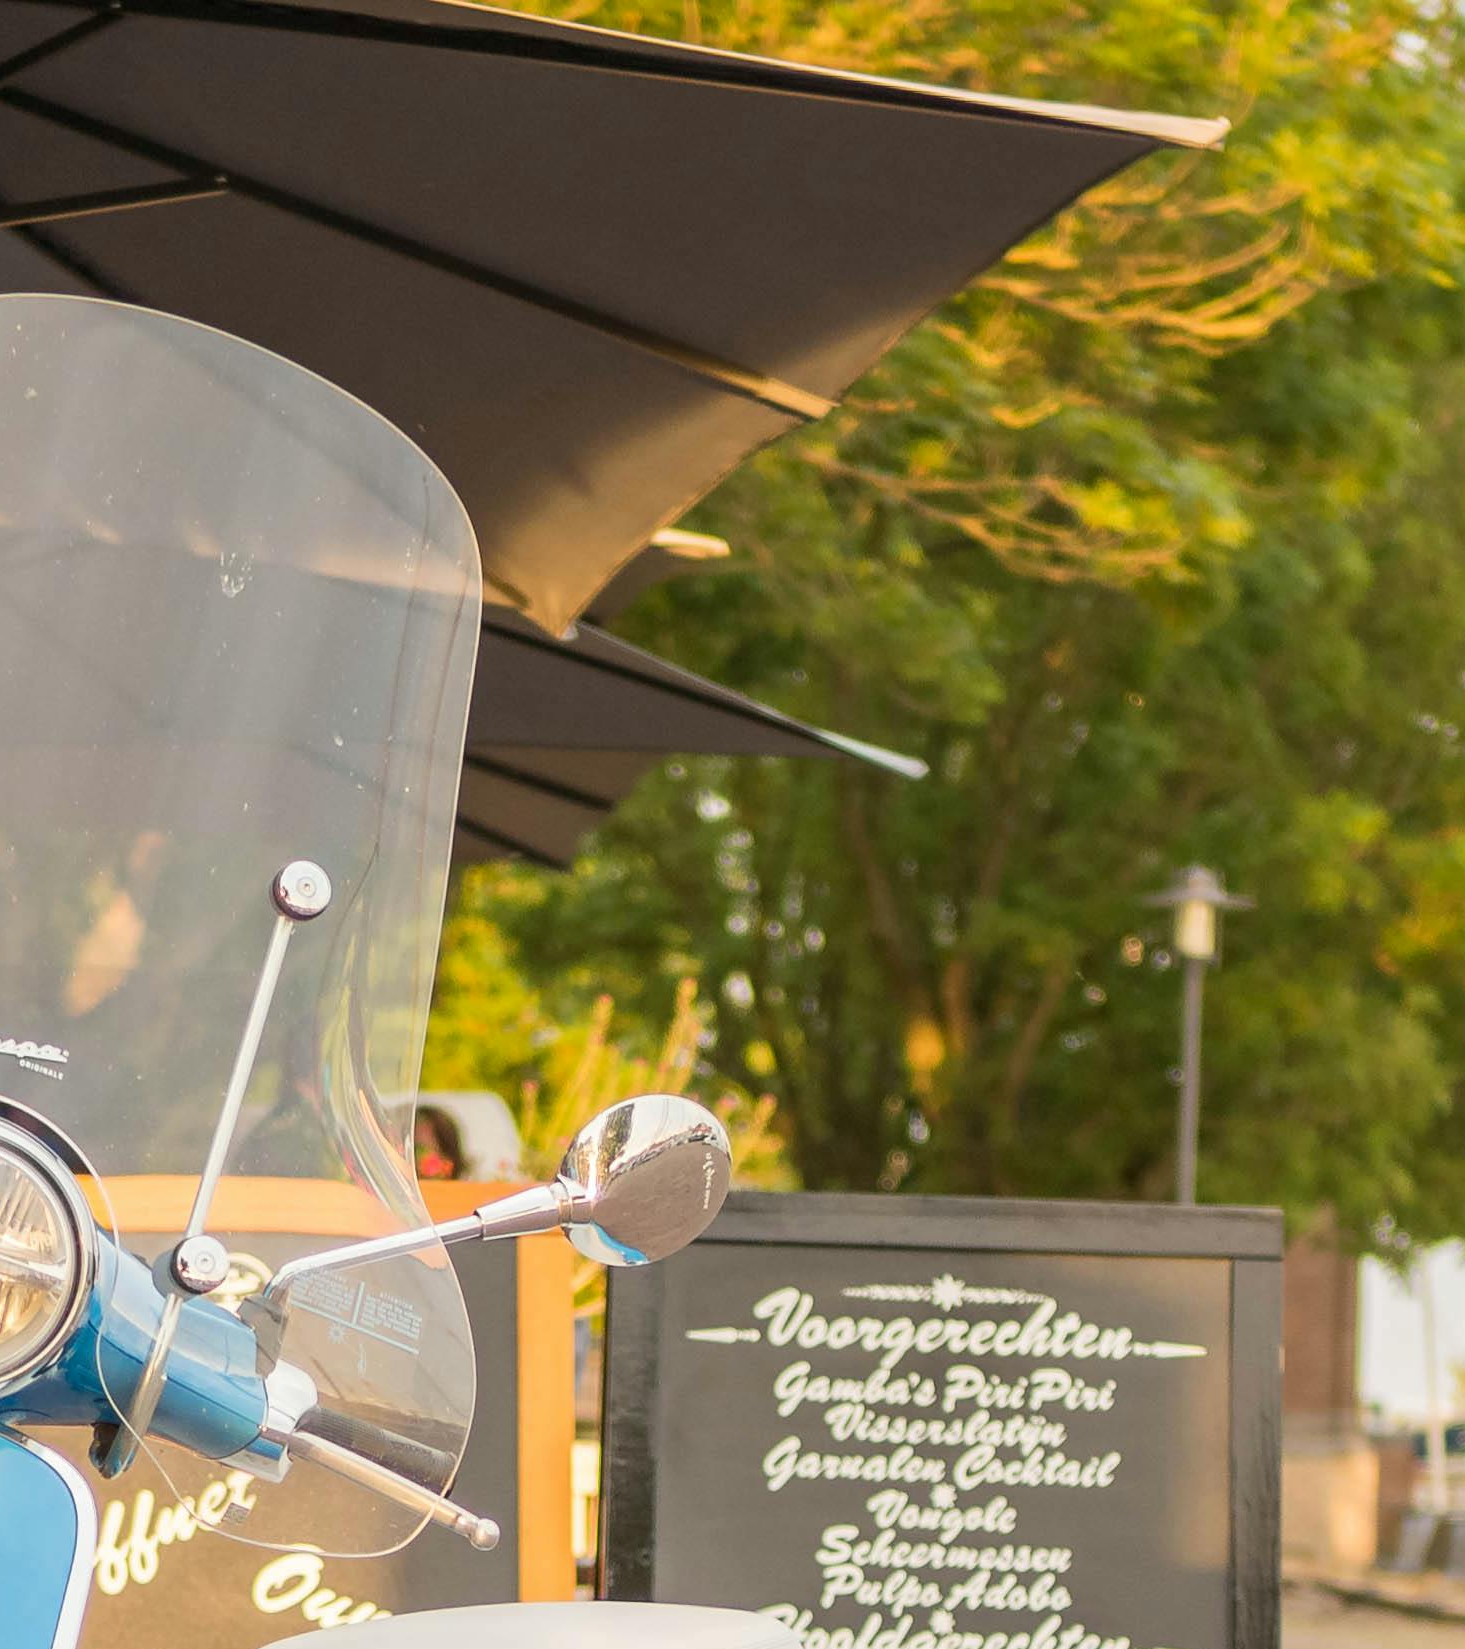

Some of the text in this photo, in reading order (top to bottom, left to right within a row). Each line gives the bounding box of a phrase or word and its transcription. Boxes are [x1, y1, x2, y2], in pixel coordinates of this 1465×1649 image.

[753, 1286, 1133, 1370] Voorgerechten
[773, 1360, 1118, 1417] Gamba's Piri Piri
[762, 1435, 1122, 1492] Garnalen Cocktail
[866, 1488, 1018, 1546] Vongole
[814, 1523, 1073, 1573] Scheermessen
[819, 1563, 1073, 1618] Pulpo Adobo
